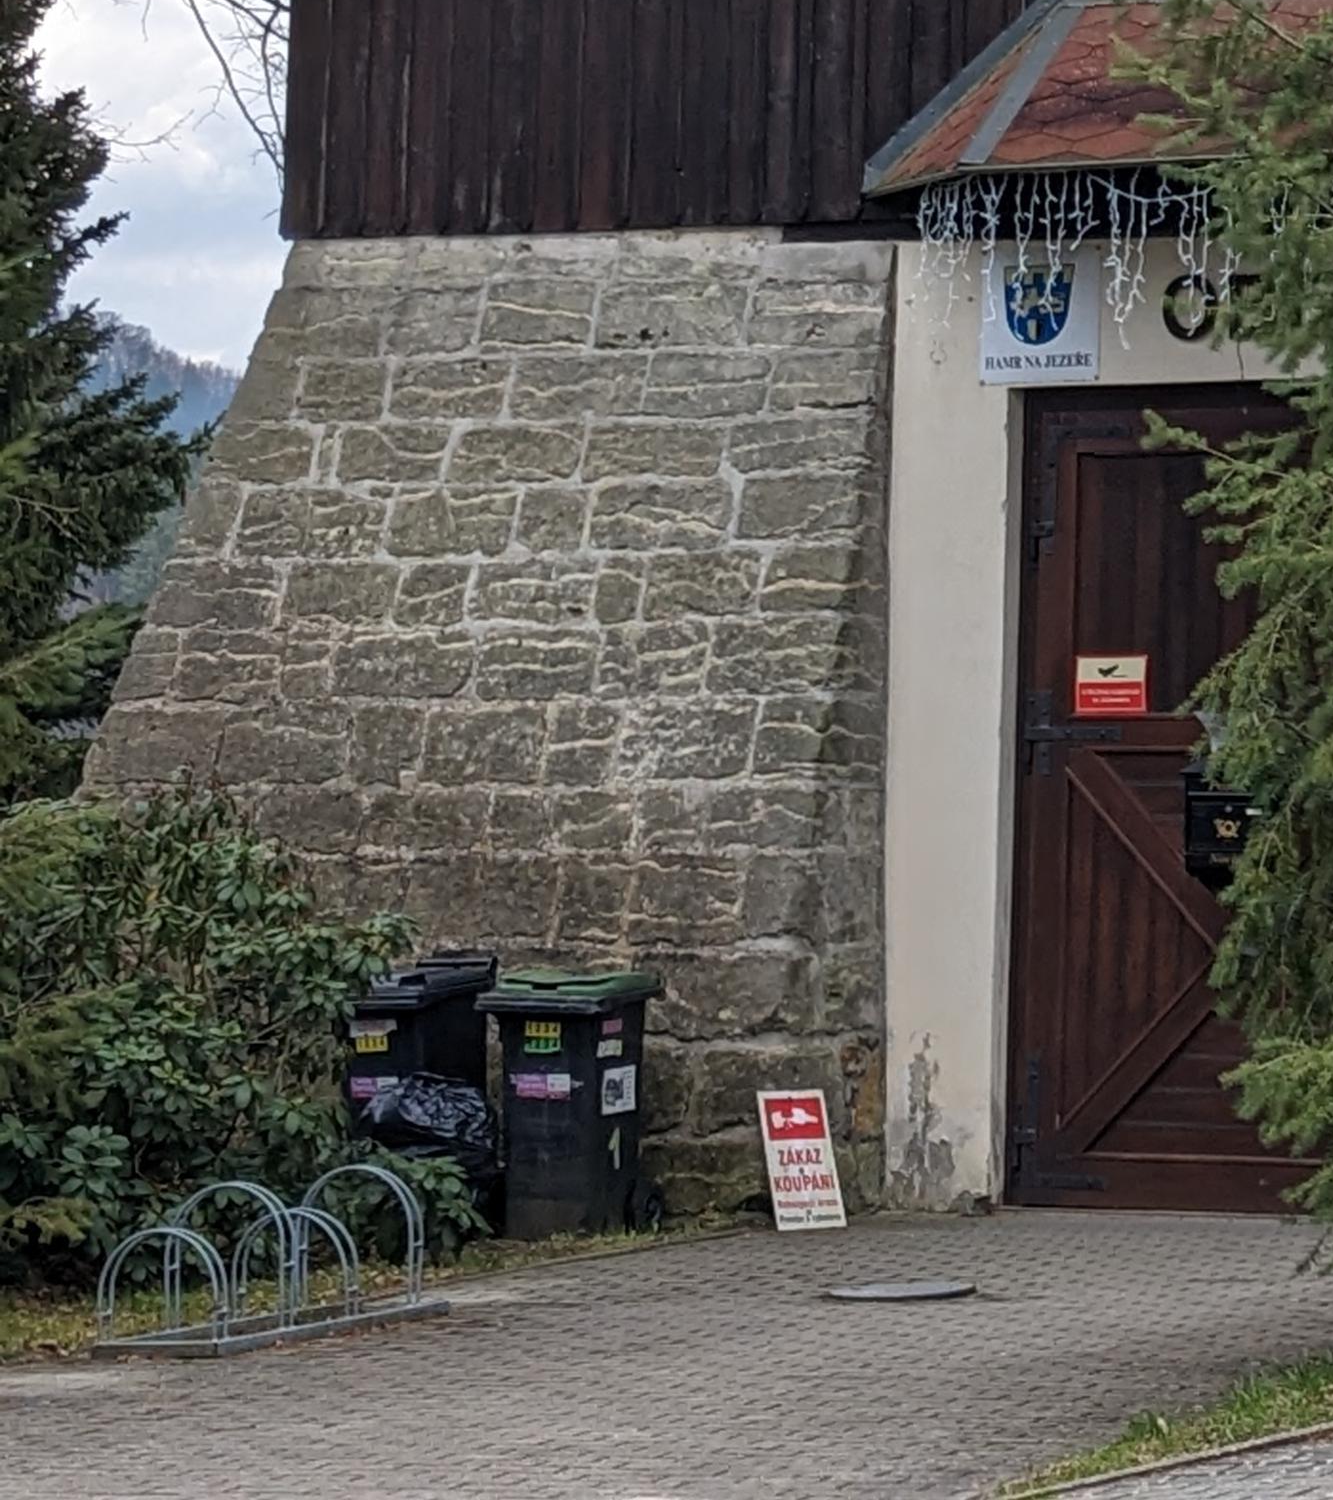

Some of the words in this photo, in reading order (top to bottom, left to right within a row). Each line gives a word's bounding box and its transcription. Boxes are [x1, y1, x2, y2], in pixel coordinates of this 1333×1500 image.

[985, 356, 1022, 370] HAMR
[1024, 355, 1041, 368] NA
[1044, 351, 1092, 368] JEZEŘE
[778, 1146, 822, 1166] ZÁKAZ
[774, 1169, 835, 1192] KOUPÁNÍ
